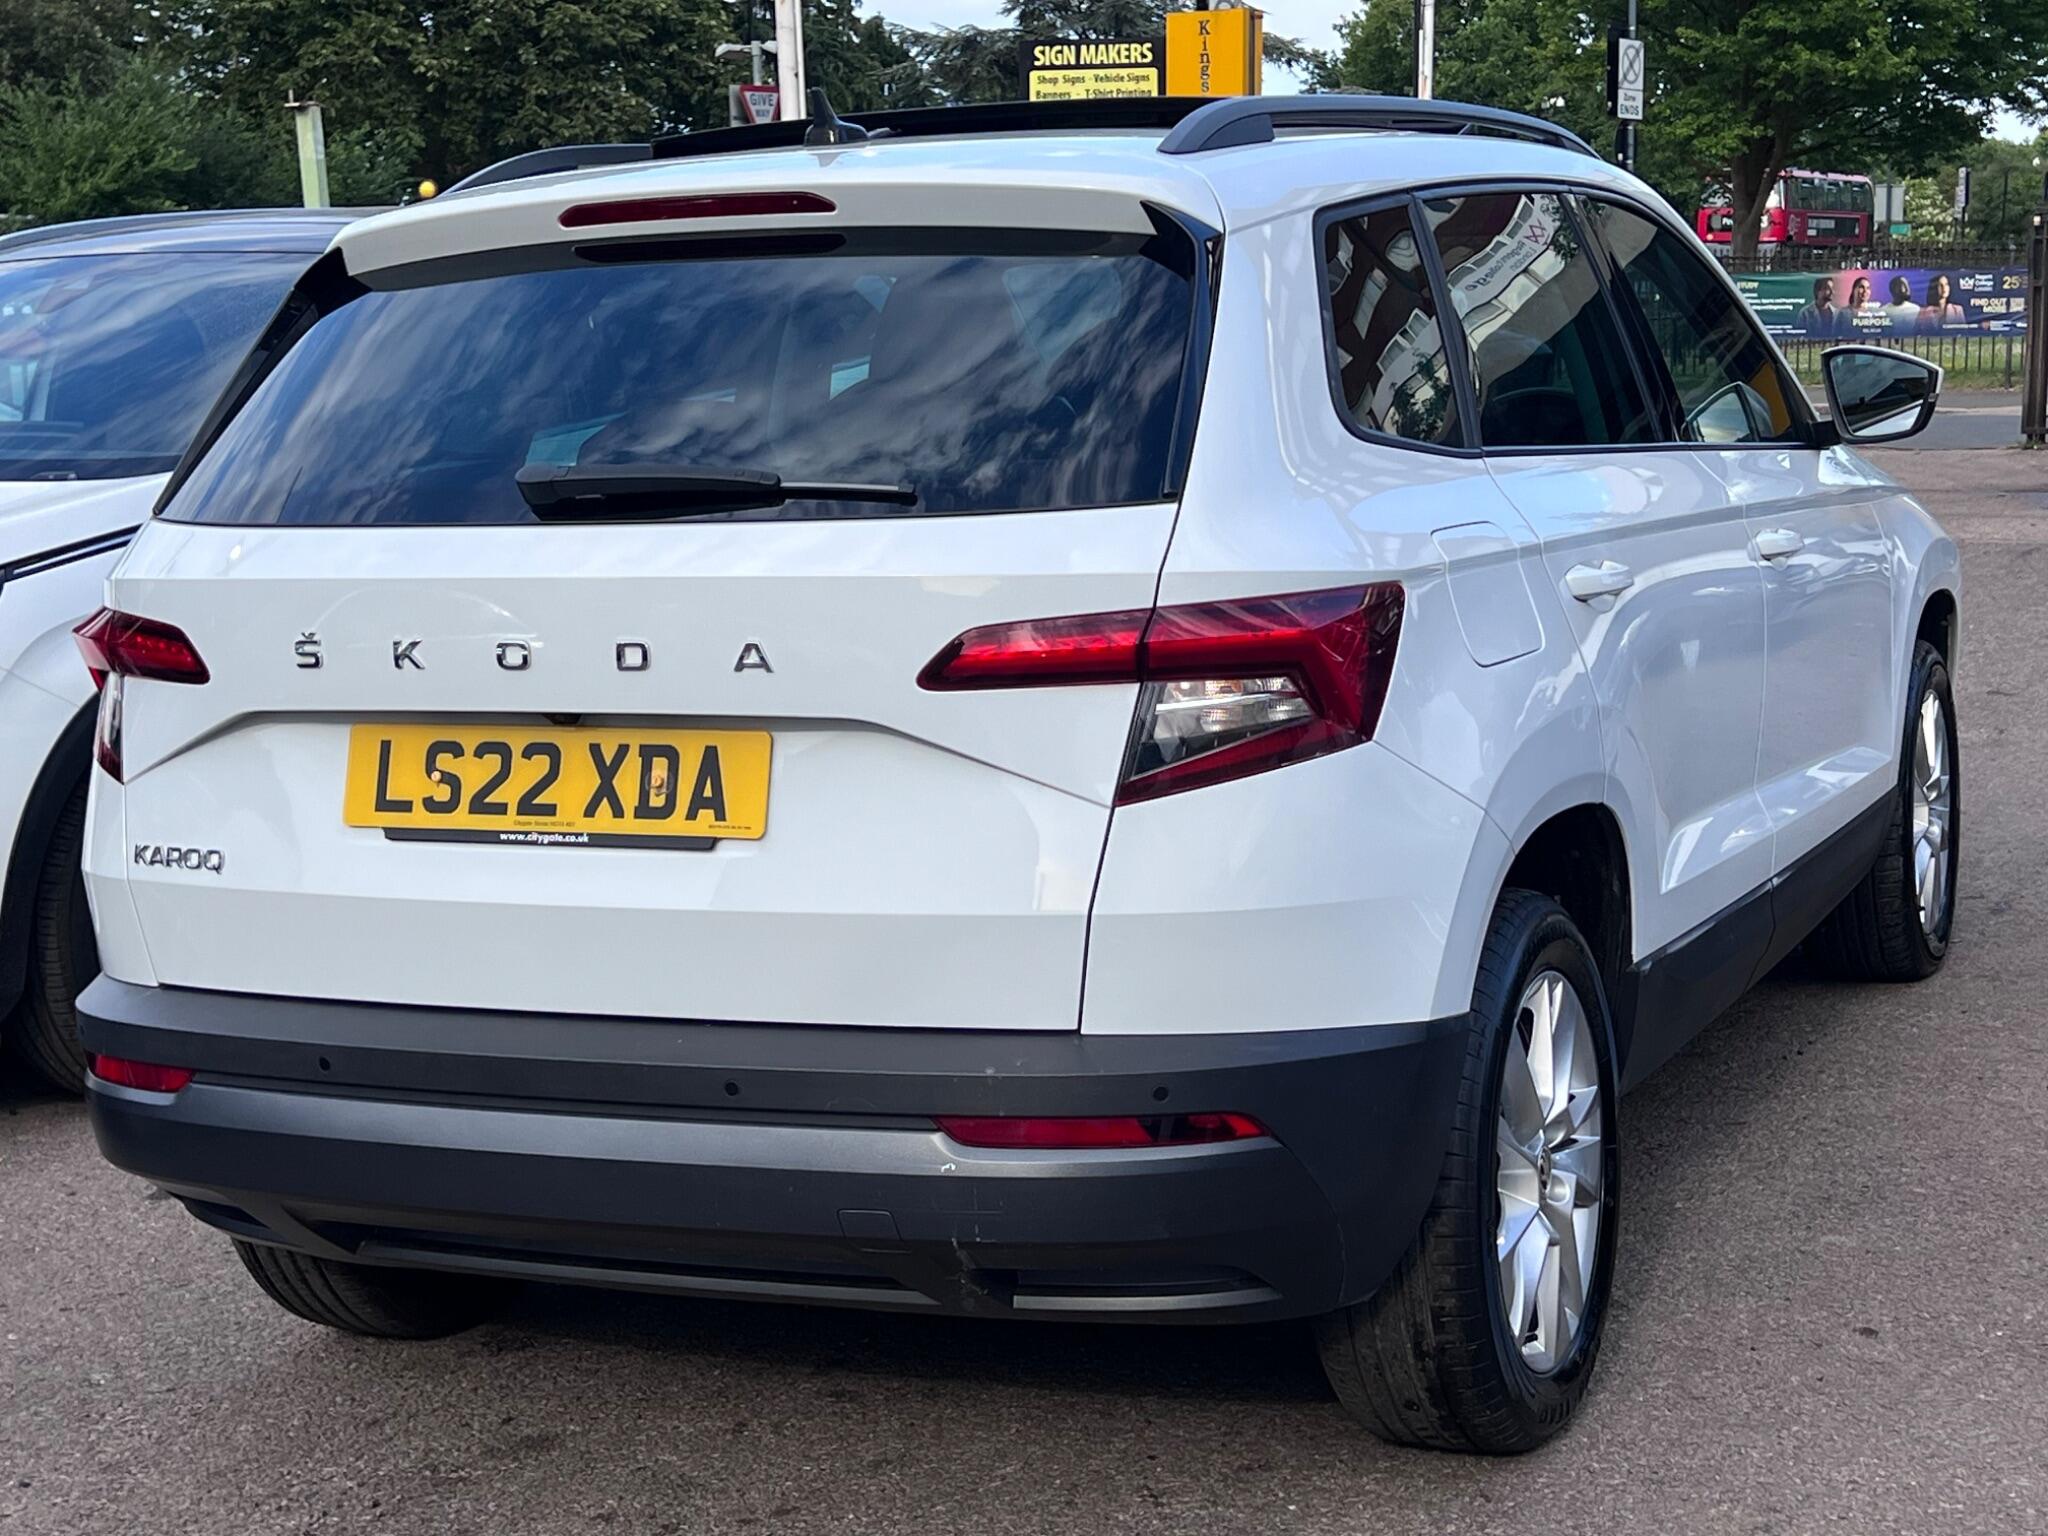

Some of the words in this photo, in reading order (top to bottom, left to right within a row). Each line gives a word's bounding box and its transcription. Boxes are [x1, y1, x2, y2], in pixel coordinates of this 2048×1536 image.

[1033, 45, 1076, 66] SIGN
[1080, 42, 1153, 64] MAKERS
[1198, 19, 1210, 92] Kings
[1037, 75, 1059, 86] Shop
[1062, 74, 1085, 85] Signs
[1093, 73, 1125, 83] Vehicle
[1126, 72, 1150, 84] Signs
[749, 93, 774, 106] GIVE
[1036, 90, 1071, 99] Banners
[1085, 88, 1114, 98] T-Shirt
[1116, 87, 1152, 97] Printing
[1620, 104, 1639, 115] ENDS
[294, 631, 774, 674] ŠKODA
[374, 738, 562, 817] LS22
[582, 742, 727, 822] XDA
[499, 831, 589, 844] www.citygate.co.uk
[133, 843, 225, 875] KAROQ
